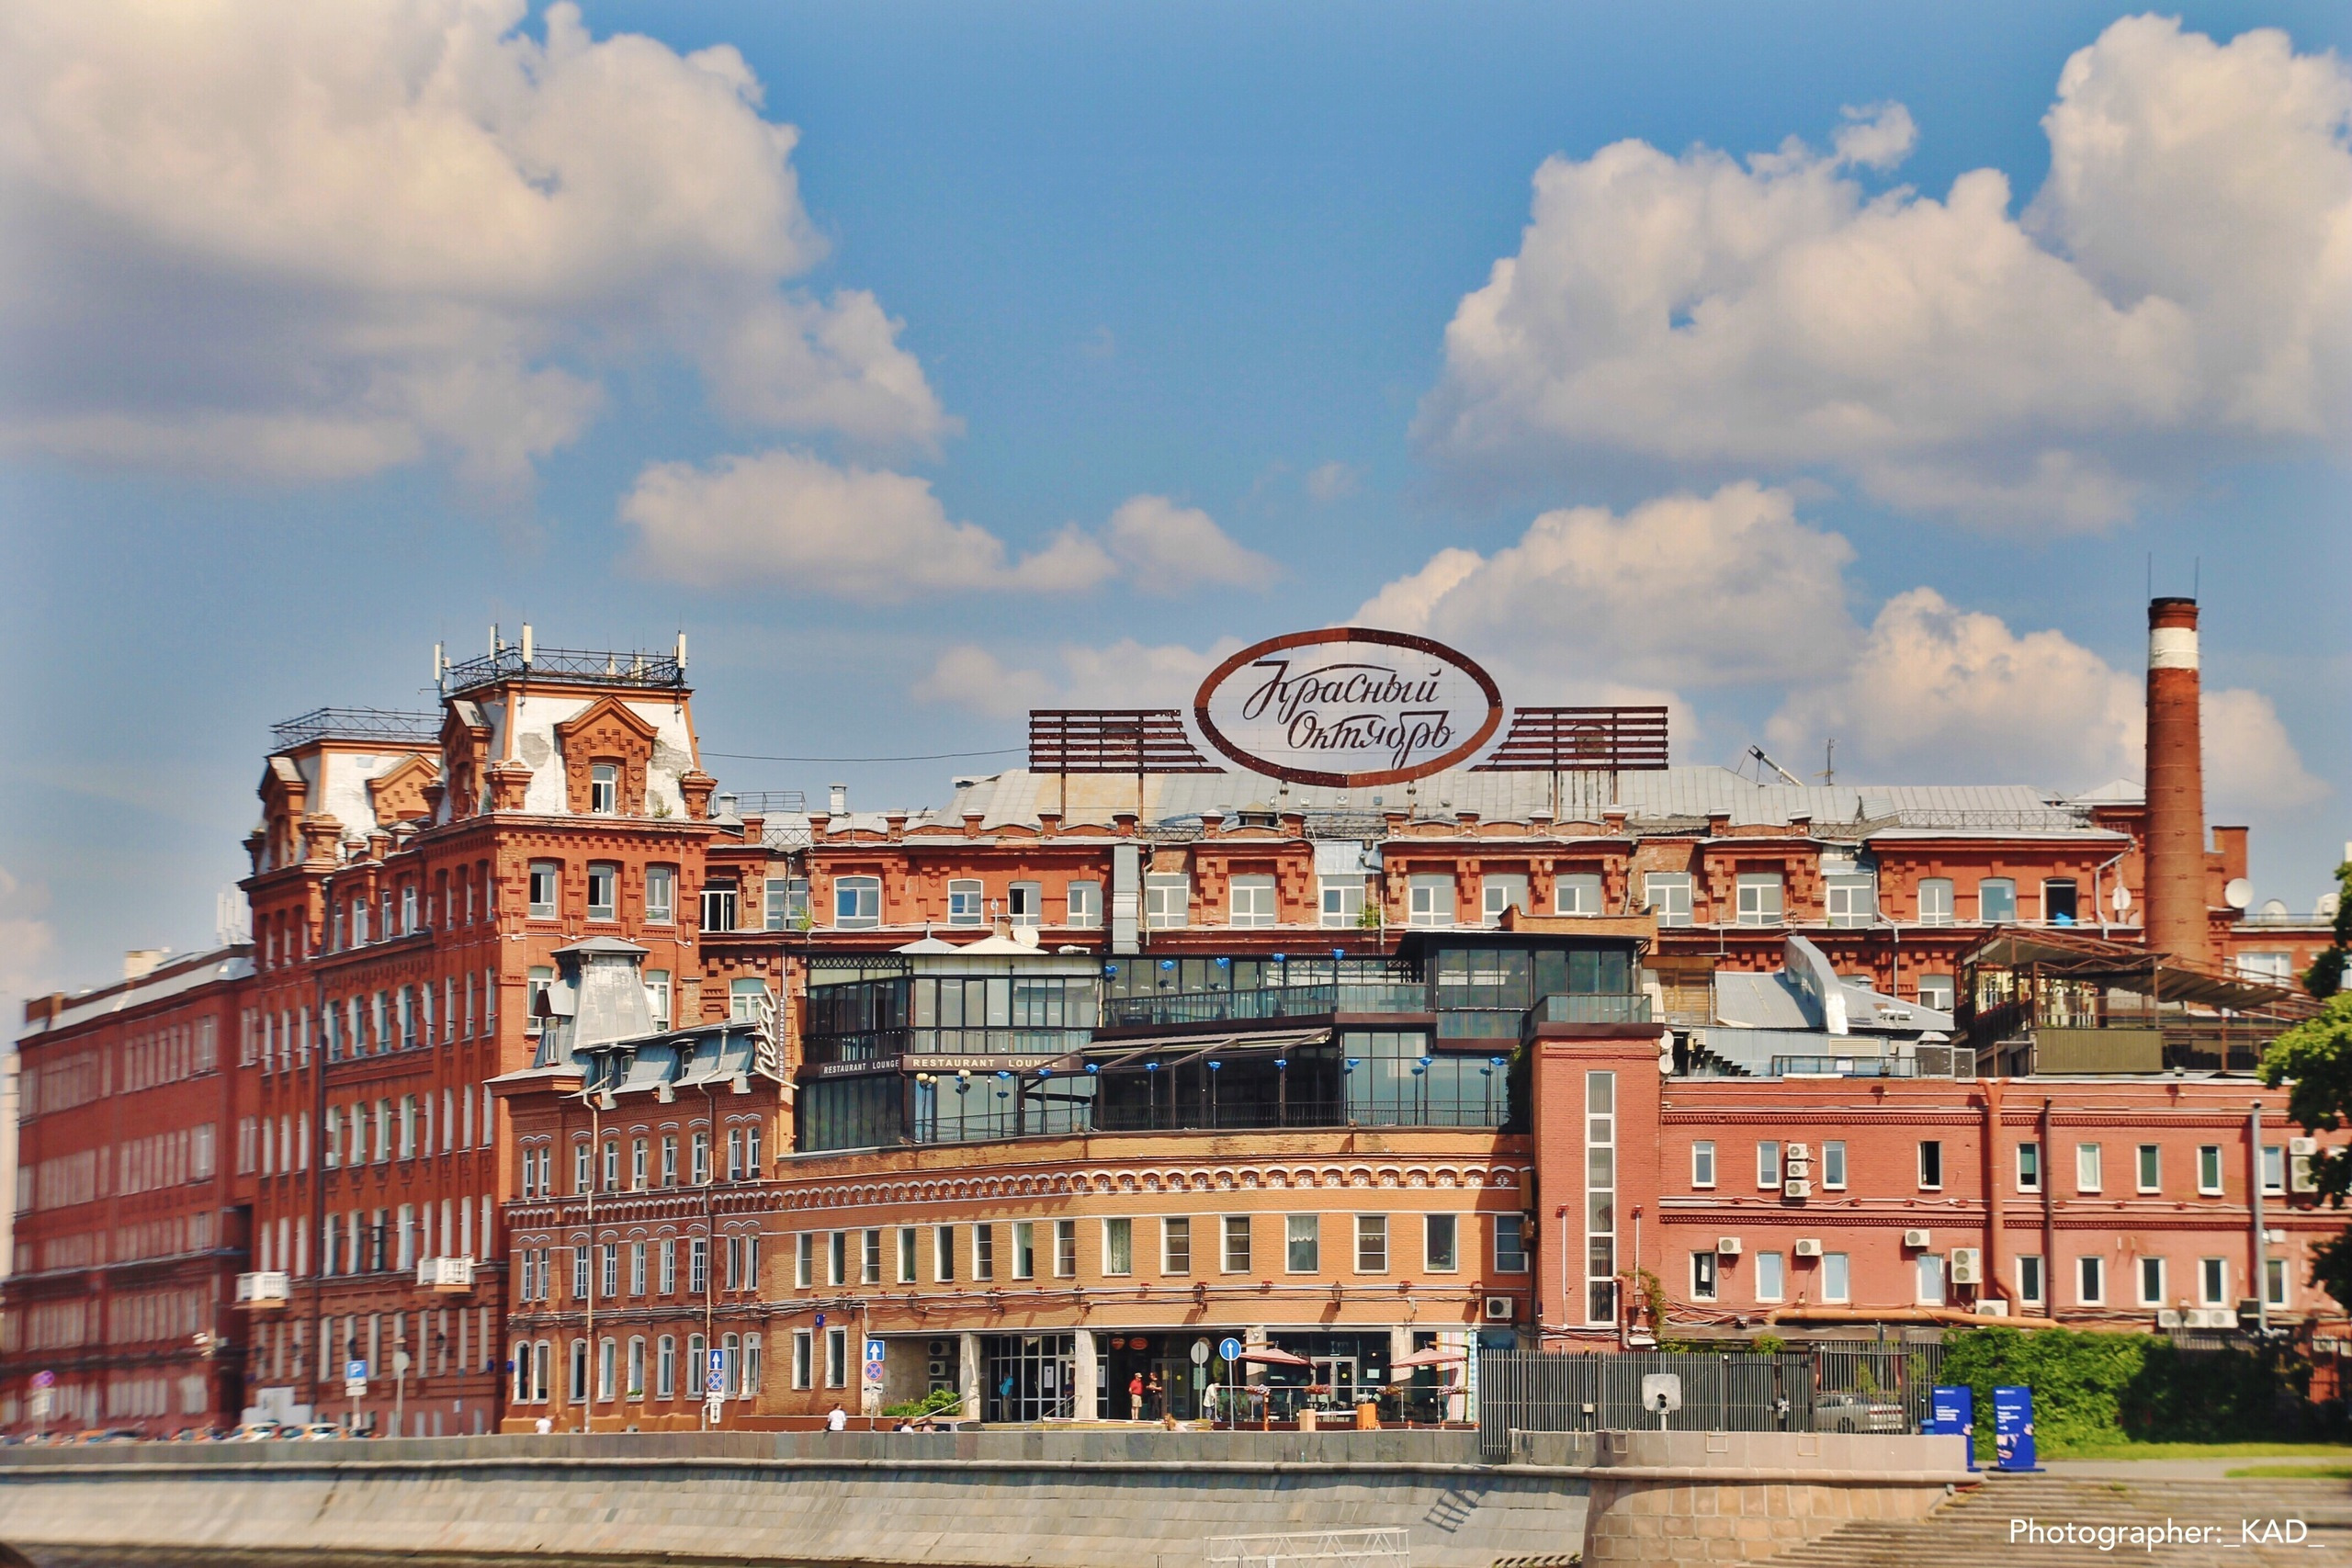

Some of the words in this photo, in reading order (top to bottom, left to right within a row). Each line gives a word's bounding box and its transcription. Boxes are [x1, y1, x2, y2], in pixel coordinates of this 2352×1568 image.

[1242, 660, 1442, 725] Красный
[1287, 709, 1456, 770] Октябрь
[823, 1063, 866, 1075] RESTAURANT
[872, 1059, 899, 1070] LOUNGE
[912, 1058, 995, 1067] RESTAURANT
